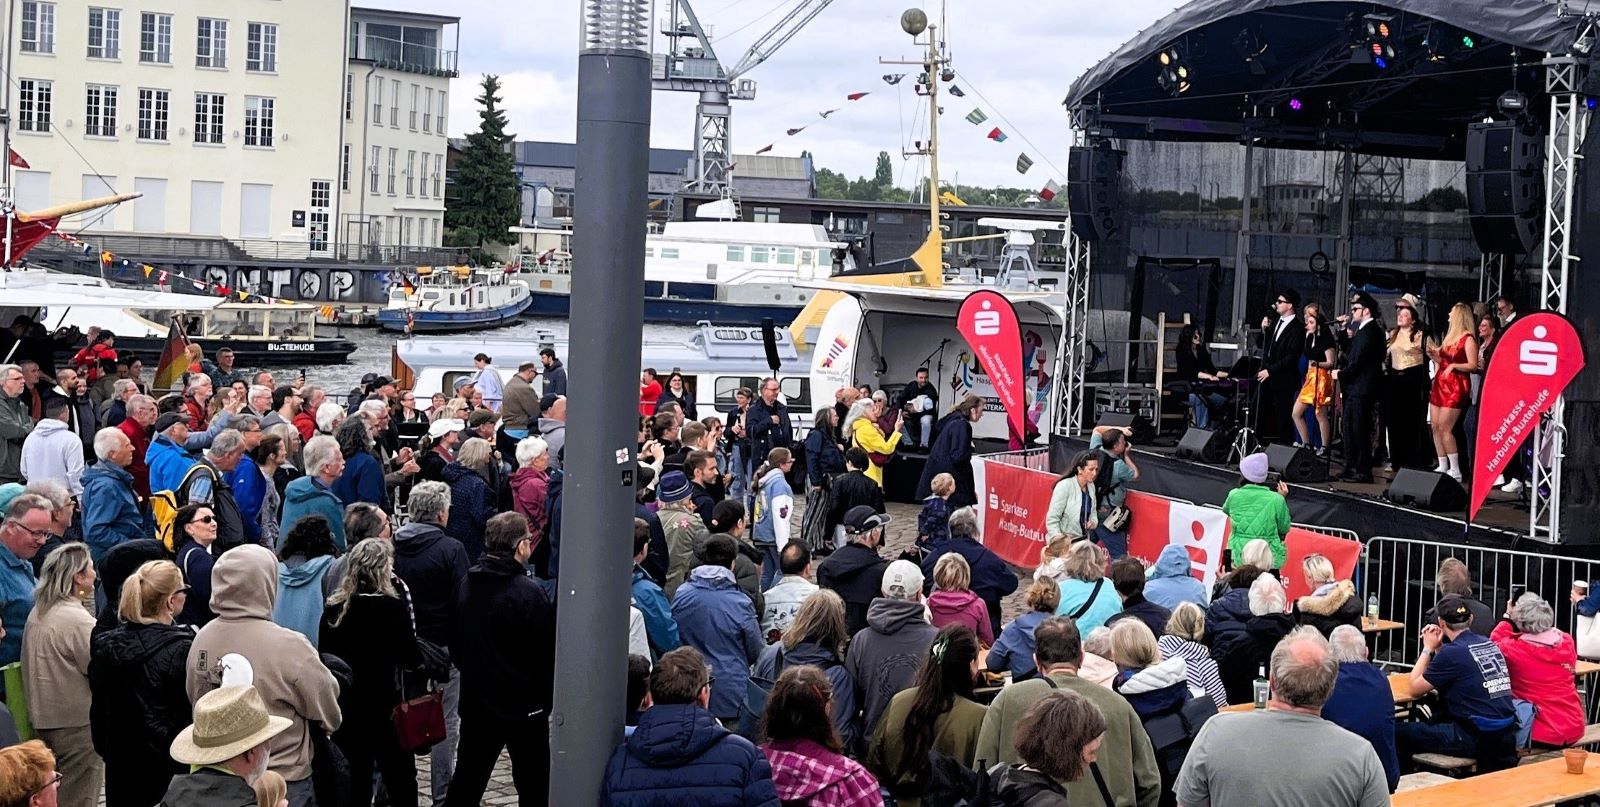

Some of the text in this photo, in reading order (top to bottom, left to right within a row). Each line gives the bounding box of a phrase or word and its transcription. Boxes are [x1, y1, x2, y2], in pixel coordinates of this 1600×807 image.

[267, 343, 315, 351] BUXTEHUDE
[1486, 388, 1550, 472] Harburg-Buxtehude
[1490, 399, 1526, 444] Sparkasse
[1001, 500, 1028, 519] Sparkasse
